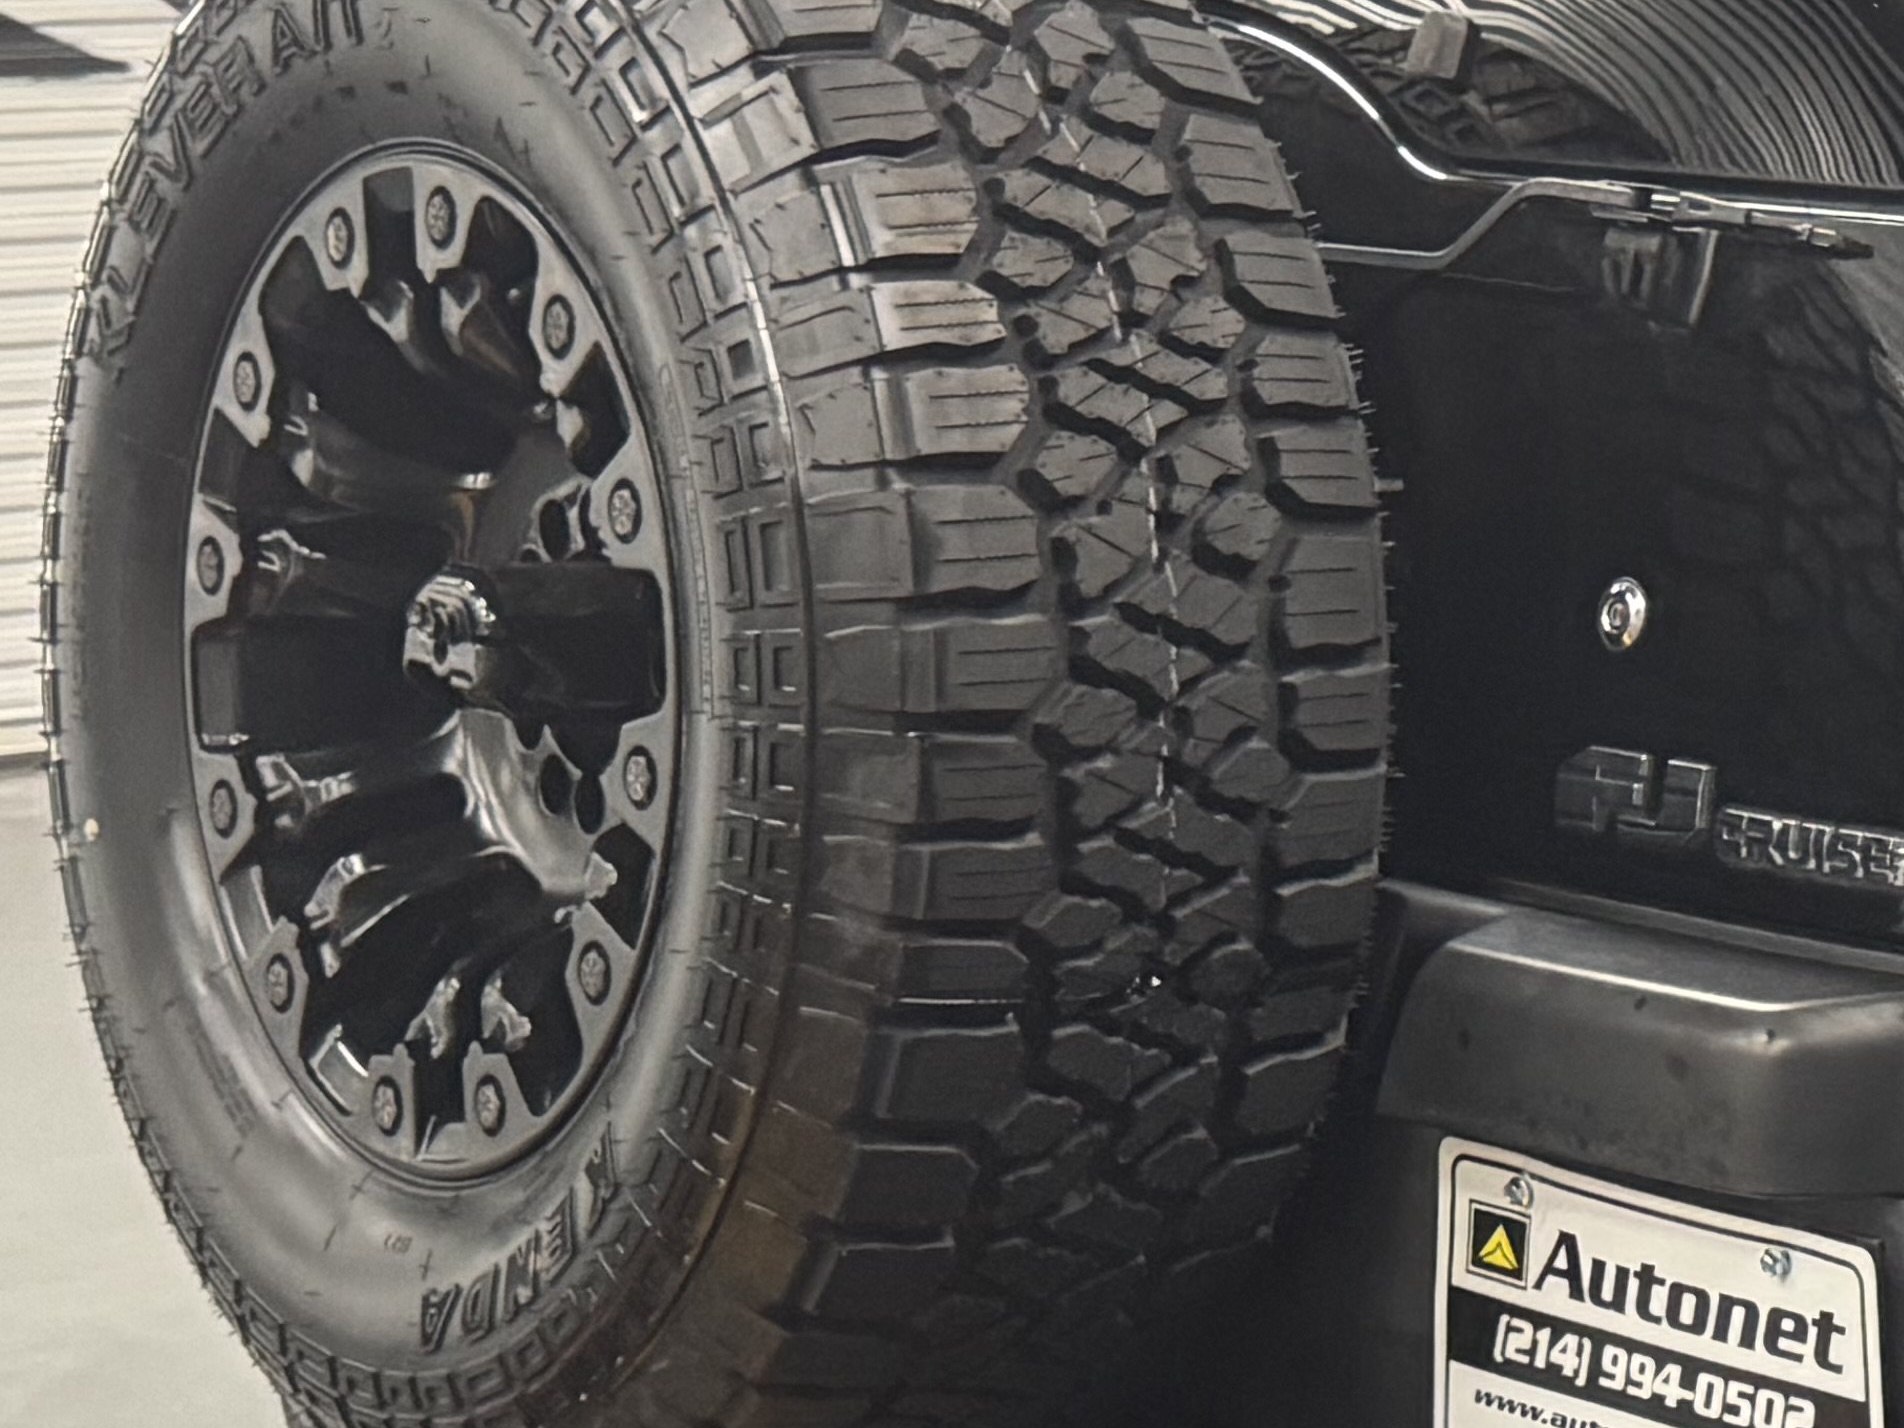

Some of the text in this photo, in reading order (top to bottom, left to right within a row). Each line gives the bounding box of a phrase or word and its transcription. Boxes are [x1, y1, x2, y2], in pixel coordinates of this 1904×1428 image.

[421, 1124, 617, 1352] KENDA
[1532, 1230, 1847, 1374] Autonet
[1493, 1314, 1590, 1387] (214)
